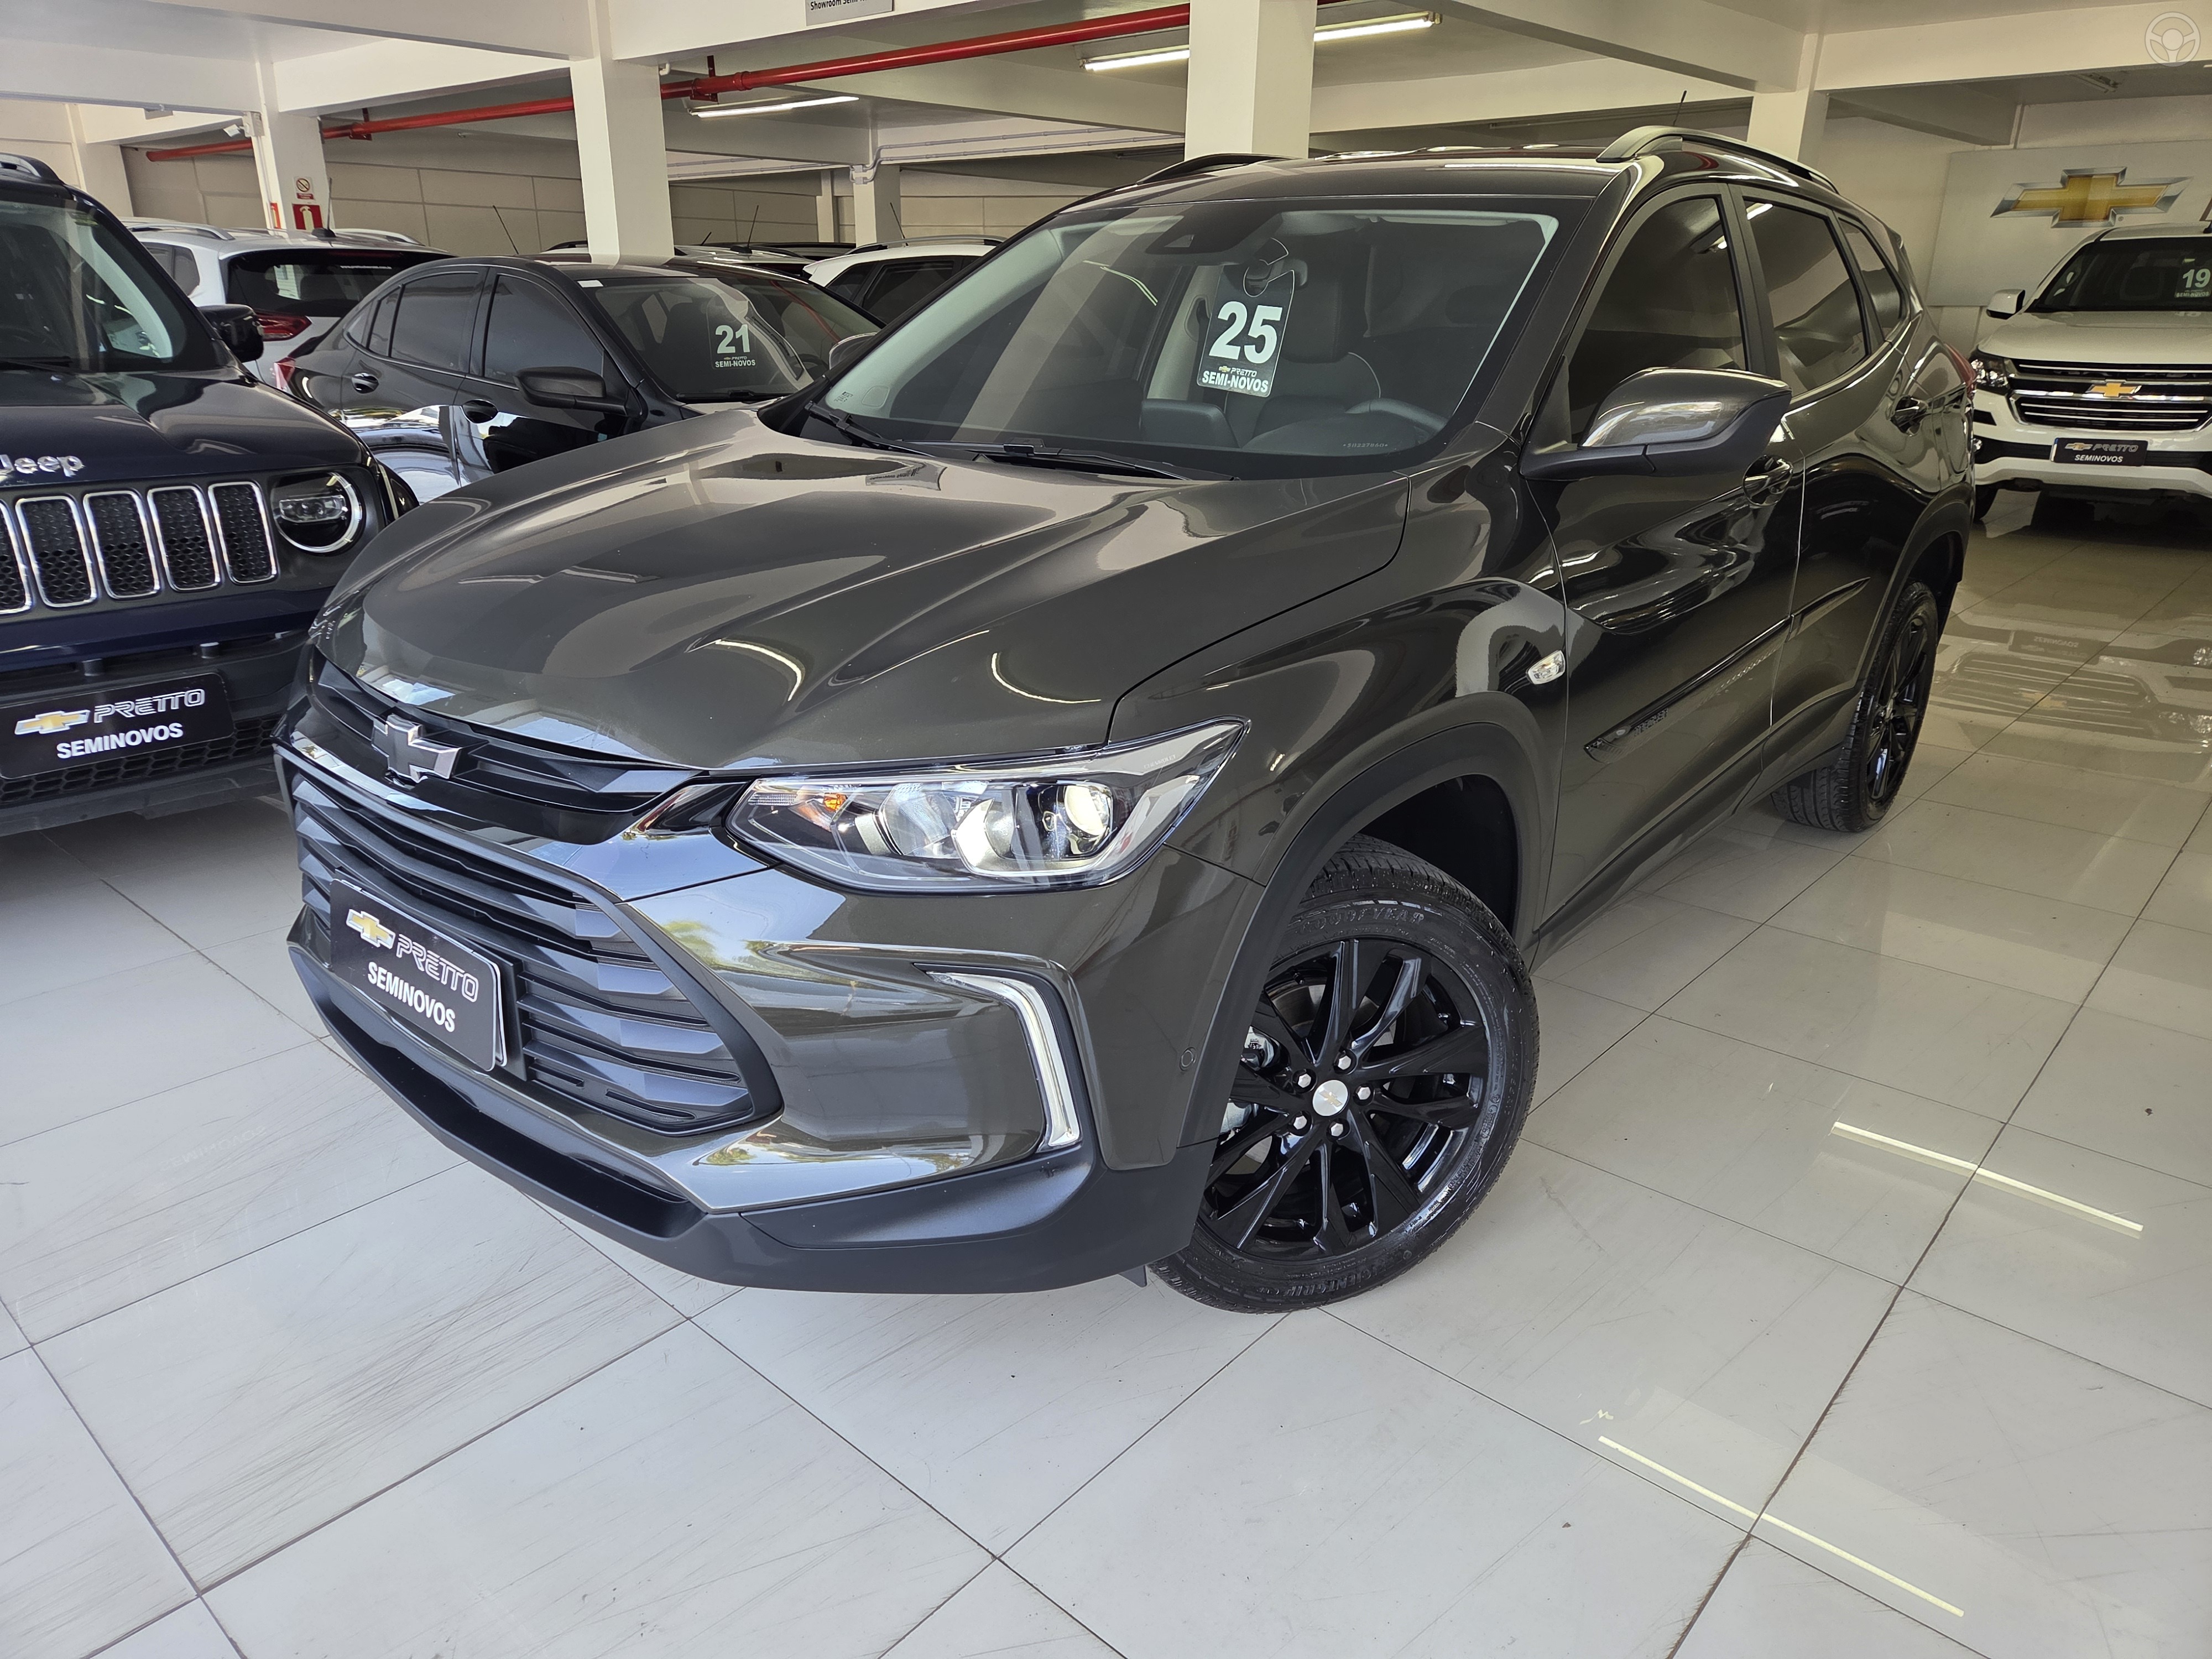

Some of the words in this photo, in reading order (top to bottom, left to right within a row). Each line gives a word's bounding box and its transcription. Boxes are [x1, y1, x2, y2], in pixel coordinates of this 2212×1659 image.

[811, 0, 841, 10] Showroom
[2183, 269, 2211, 288] 19
[715, 324, 750, 354] 21
[1209, 301, 1283, 364] 25
[715, 359, 756, 368] SEMI-NOVOS
[1230, 367, 1258, 378] PRETTO
[1202, 371, 1269, 393] SEMI-NOVOS
[2074, 455, 2124, 463] SEMINOVOS
[2092, 444, 2139, 452] PRETTO
[93, 688, 205, 723] PRETTO
[56, 723, 183, 759] SEMINOVOS
[396, 933, 479, 1003] PRETTO
[368, 962, 456, 1032] SEMINOVOS
